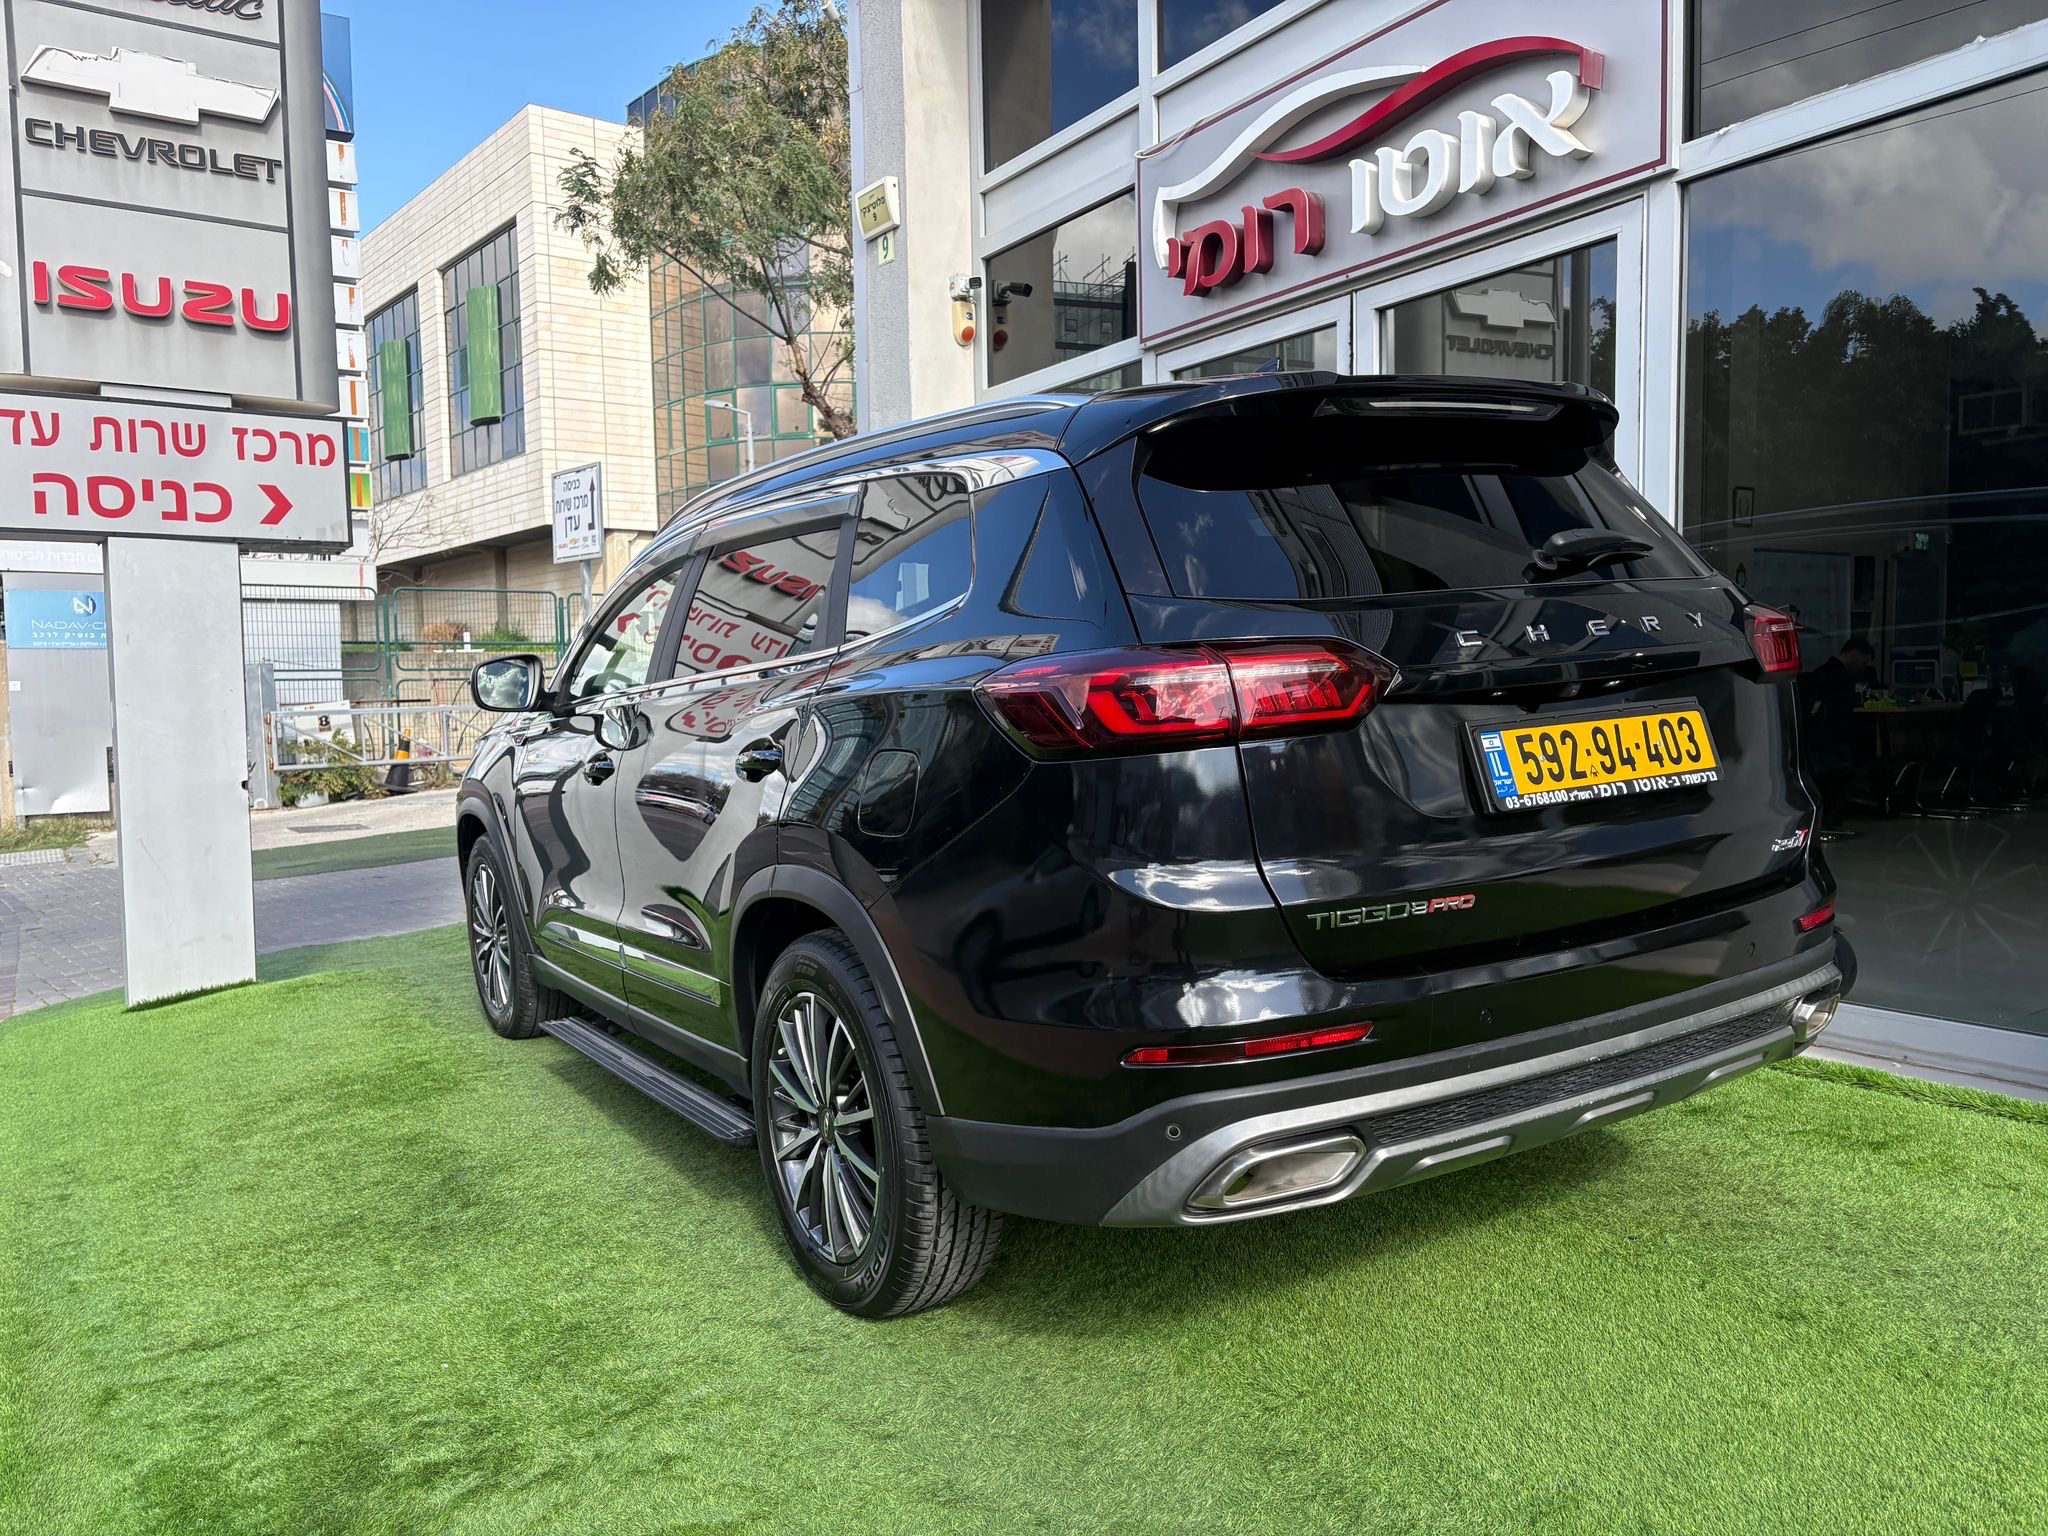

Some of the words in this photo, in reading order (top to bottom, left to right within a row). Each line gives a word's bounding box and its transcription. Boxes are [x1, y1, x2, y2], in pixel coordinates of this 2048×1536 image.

[25, 117, 282, 182] CHEVROLET
[1348, 70, 1593, 237] אוטו
[872, 212, 878, 222] 9
[882, 234, 889, 260] 9
[1167, 187, 1326, 298] רומי
[32, 260, 291, 332] ISUZU
[89, 416, 207, 458] שרות
[232, 426, 336, 467] מרכז
[32, 472, 233, 523] כניסה
[563, 478, 581, 492] כניסה
[573, 494, 589, 510] מרכז
[565, 514, 581, 539] עדן
[1455, 611, 1703, 649] CHERY
[1489, 751, 1509, 777] IL
[1592, 781, 1628, 798] רומי
[1682, 770, 1718, 785] נרכשתי
[1505, 789, 1568, 809] 03-6768100
